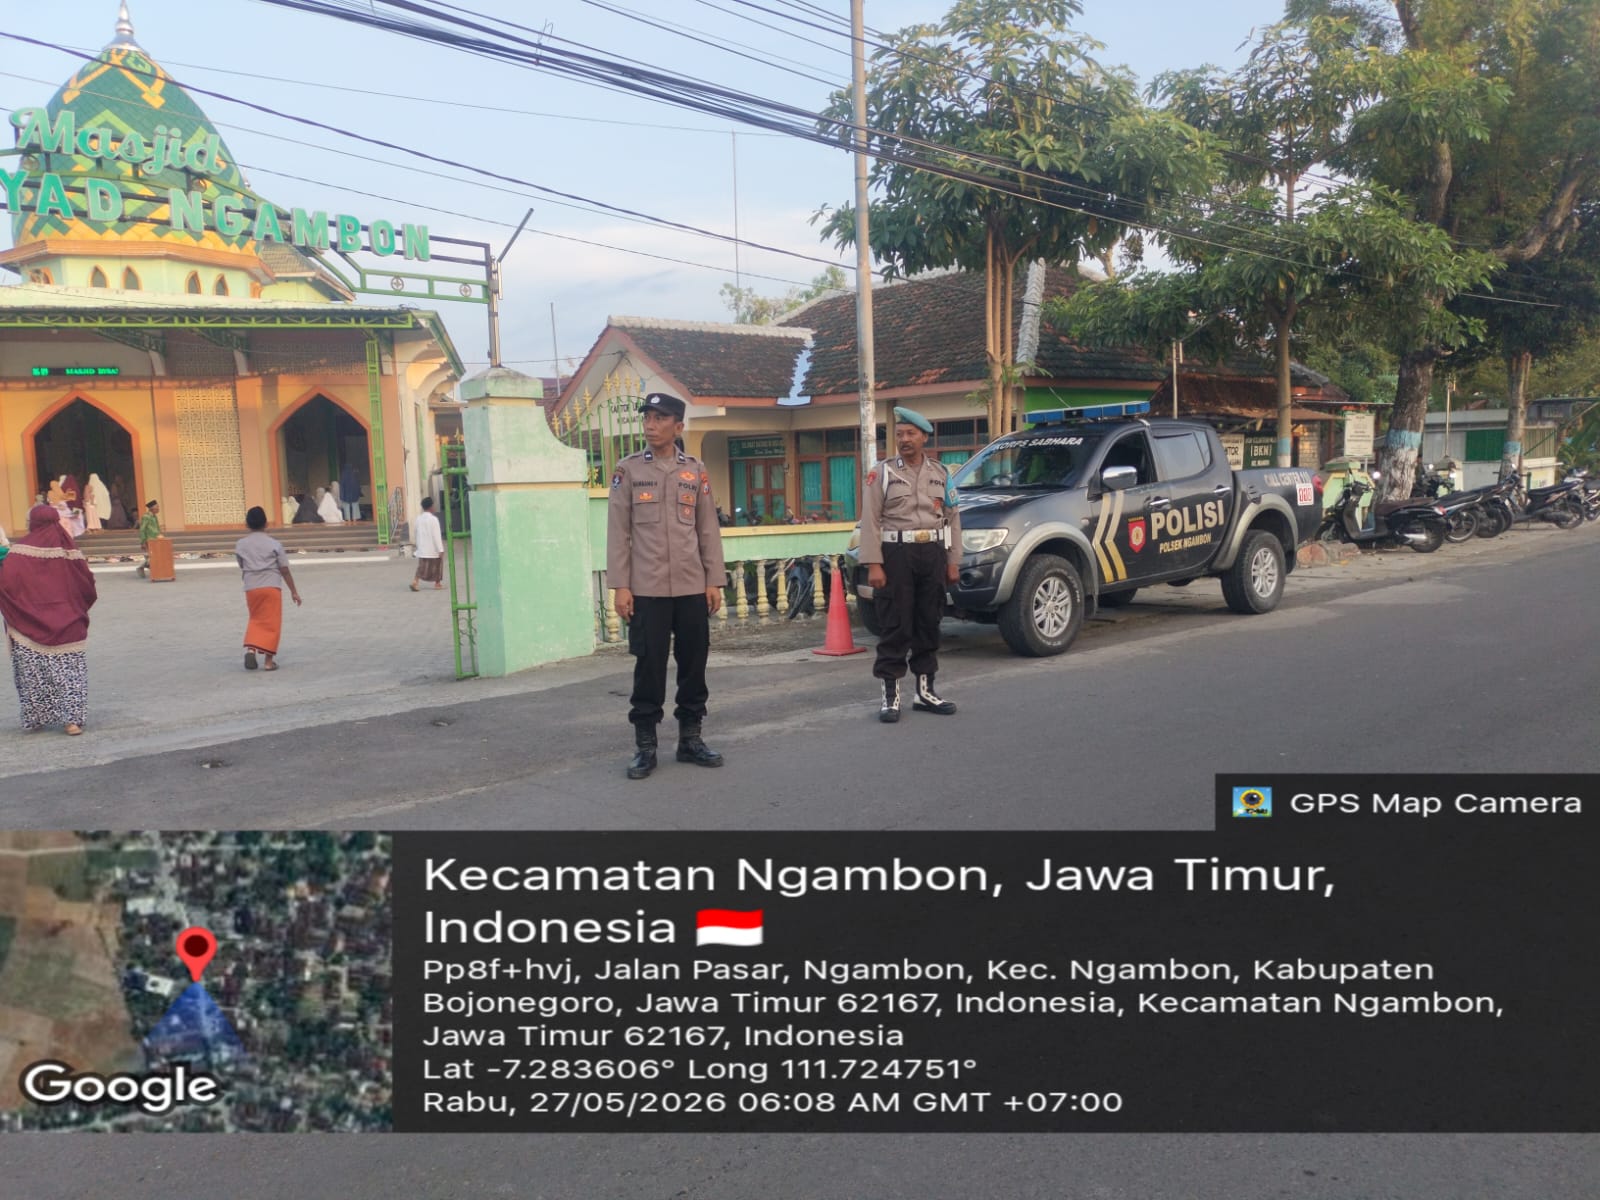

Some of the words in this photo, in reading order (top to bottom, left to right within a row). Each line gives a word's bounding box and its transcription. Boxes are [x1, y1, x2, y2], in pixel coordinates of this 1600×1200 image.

[9, 107, 224, 176] Masjid
[168, 187, 431, 261] NGAMBON
[1029, 437, 1083, 447] SABHARA
[678, 481, 698, 492] POLRI
[1150, 499, 1225, 541] POLISI
[1159, 538, 1183, 554] POLSEK
[1183, 532, 1212, 549] NGAMBON
